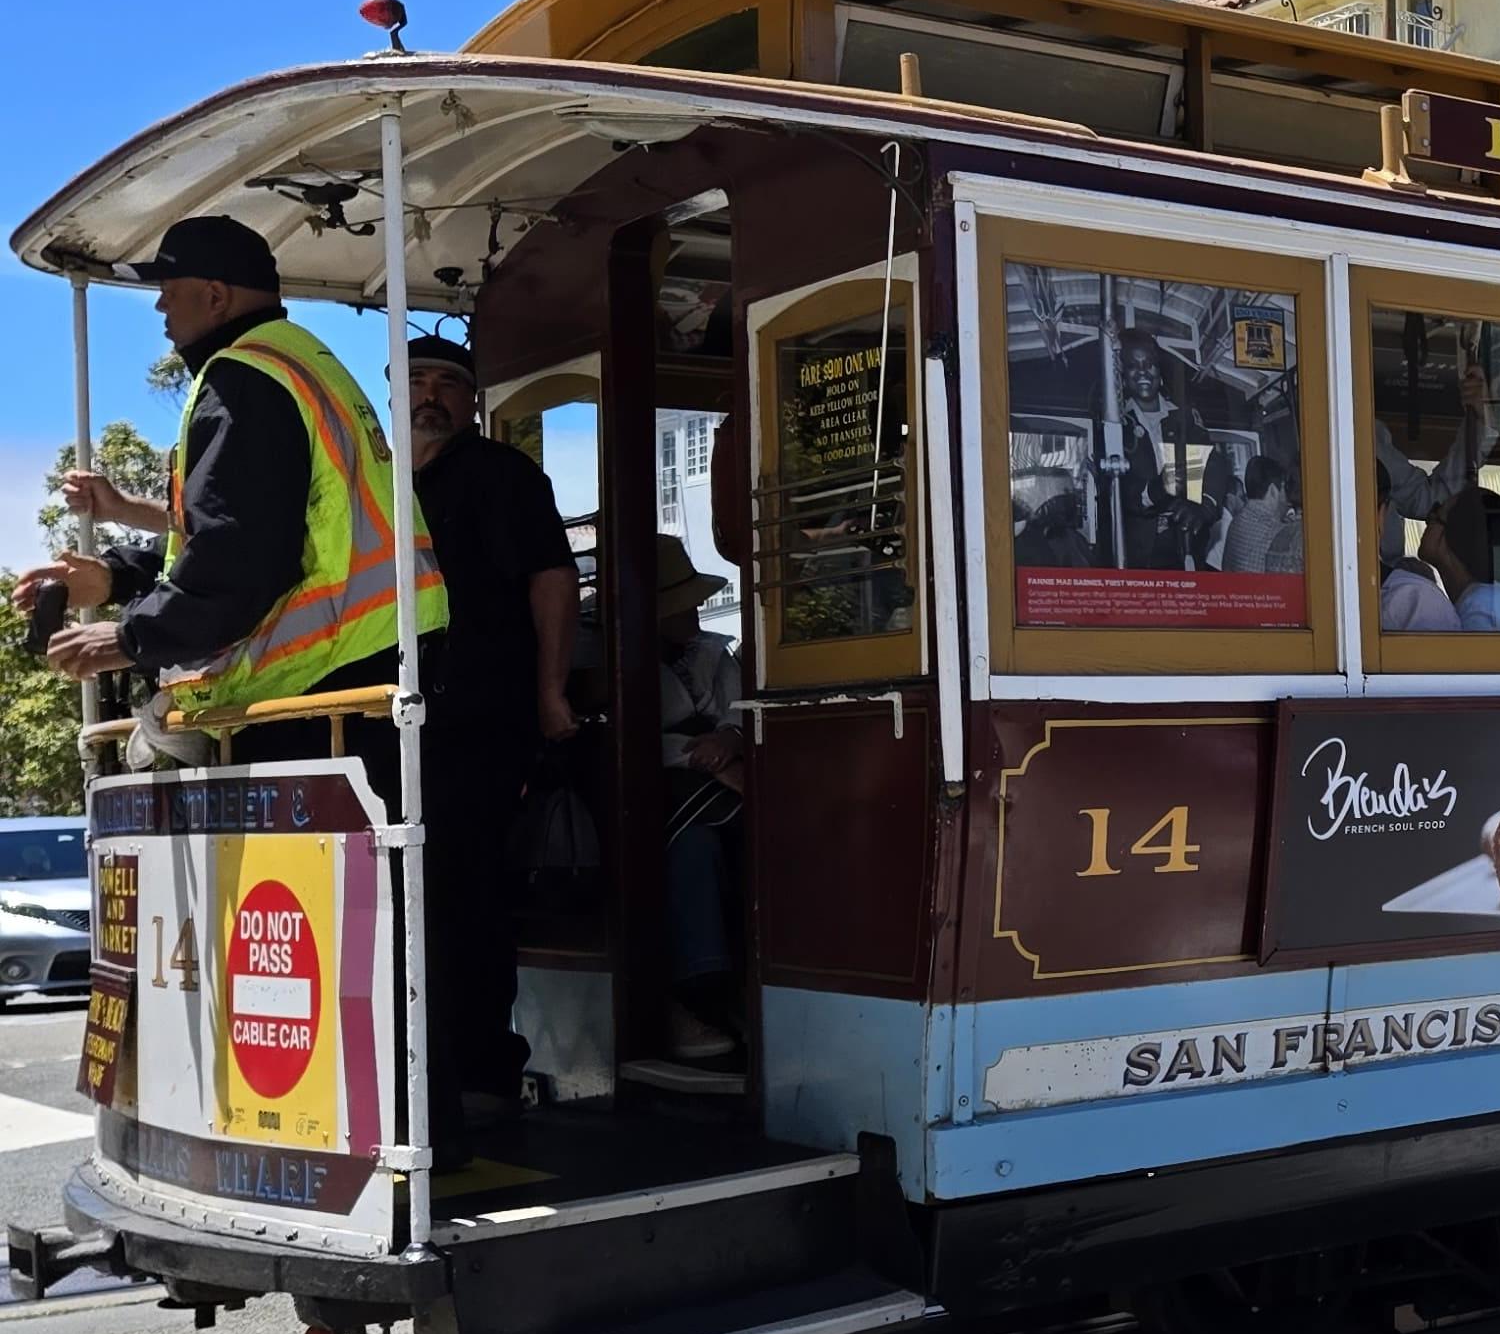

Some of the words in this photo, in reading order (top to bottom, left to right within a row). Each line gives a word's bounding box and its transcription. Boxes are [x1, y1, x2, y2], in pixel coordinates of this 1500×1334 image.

[800, 363, 821, 387] FARE
[844, 351, 864, 376] ONE
[865, 346, 883, 370] WA
[809, 403, 826, 417] KEEP
[827, 397, 853, 412] YELLOW
[855, 389, 878, 405] FLOOR
[826, 382, 846, 397] HOLD
[848, 378, 860, 390] ON
[820, 415, 840, 429] AREA
[842, 409, 867, 425] CLEAR
[830, 424, 872, 446] TRANSFERS
[857, 441, 877, 456] DRIN
[1027, 577, 1055, 586] FANNIE
[1056, 578, 1072, 586] MAE
[1105, 579, 1125, 587] FIRST
[1126, 579, 1154, 587] WOMAN
[1155, 580, 1164, 588] AT
[1166, 580, 1180, 588] THE
[1301, 737, 1457, 841] Brenda's
[290, 784, 312, 828] &
[1075, 805, 1201, 877] 14
[1344, 823, 1385, 835] FRENCH
[1388, 821, 1415, 832] SOUL
[1418, 820, 1446, 831] FOOD
[100, 867, 137, 897] POWELL
[106, 899, 126, 921] AND
[240, 910, 263, 941] DO
[267, 911, 304, 942] NOT
[151, 915, 201, 992] 14
[250, 942, 292, 974] PASS
[233, 1019, 276, 1047] CABLE
[279, 1024, 311, 1050] CAR
[1122, 1031, 1249, 1089] SAN
[215, 1148, 328, 1204] WHARF
